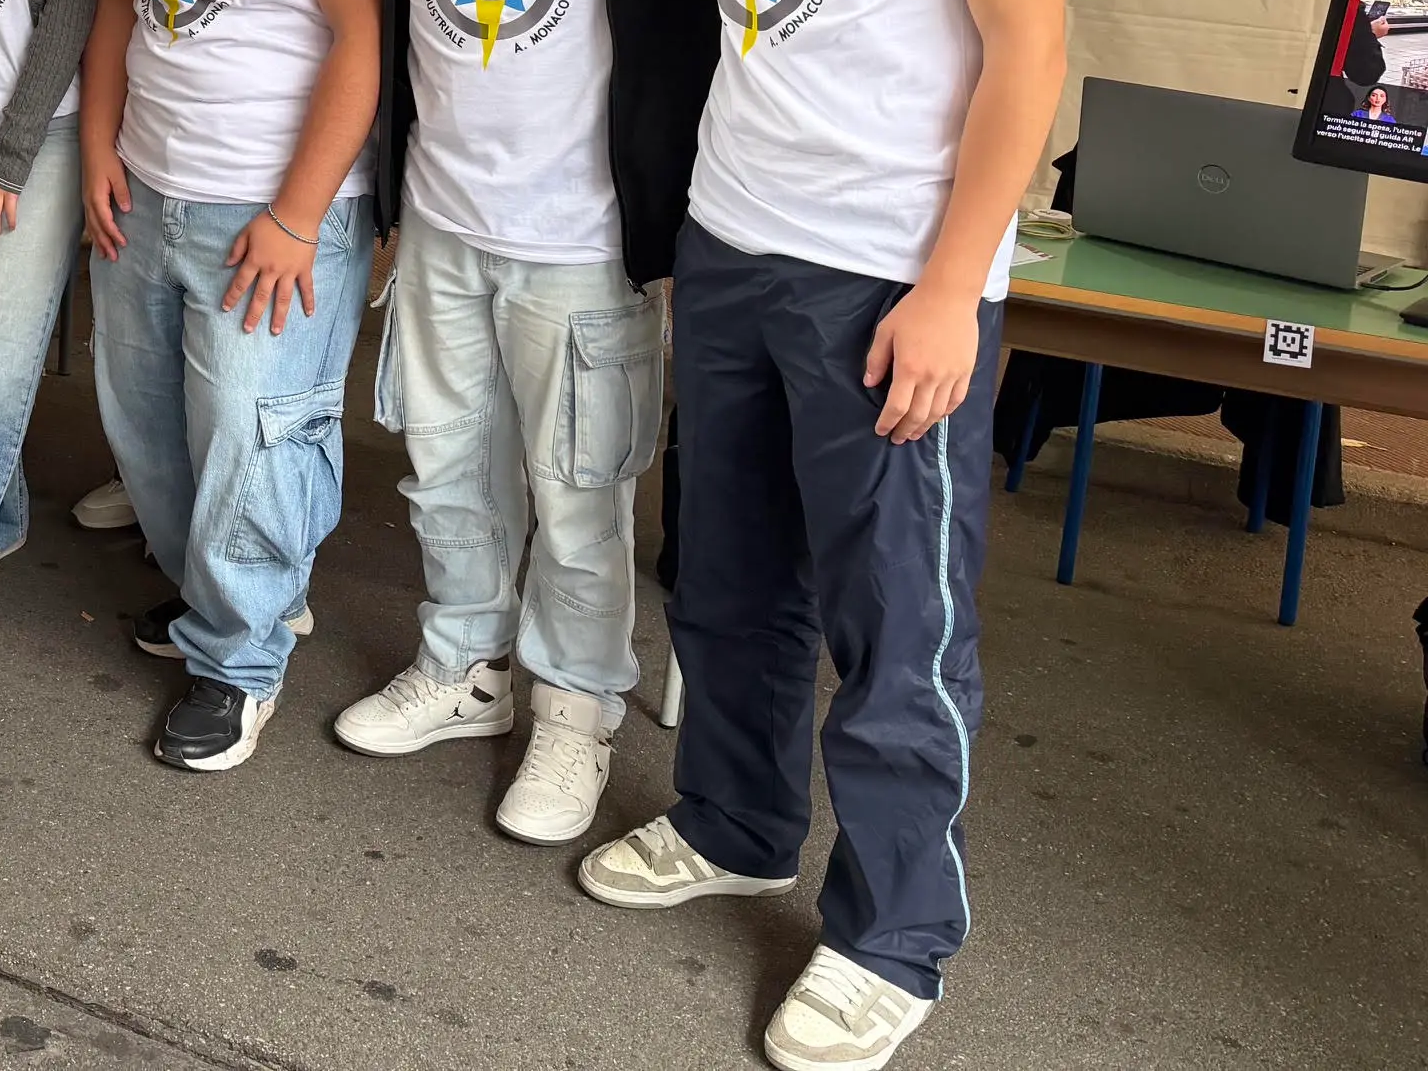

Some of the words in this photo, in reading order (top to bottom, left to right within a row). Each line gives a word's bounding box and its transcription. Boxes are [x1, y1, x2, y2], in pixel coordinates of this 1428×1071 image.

[514, 42, 528, 54] A.
[530, 0, 570, 46] MONACO
[1323, 115, 1359, 127] Terminata
[1368, 123, 1391, 133] spesa,
[1327, 124, 1342, 132] può
[1342, 126, 1370, 137] seguire
[1380, 133, 1401, 143] guida
[1316, 130, 1337, 139] verso
[1378, 140, 1410, 151] negozio.
